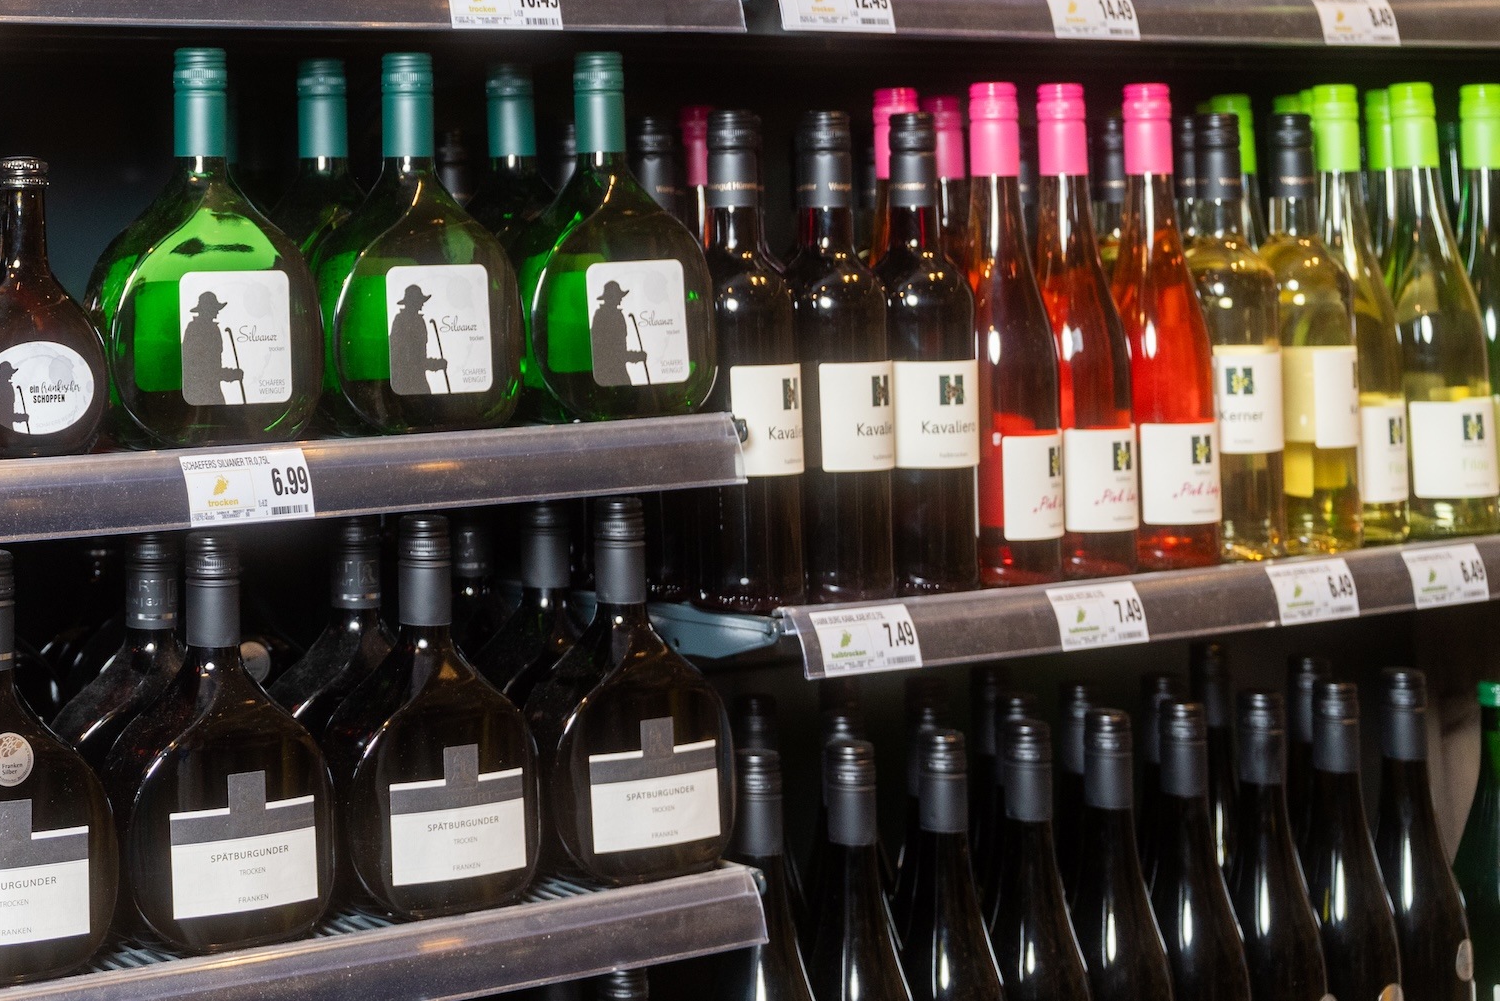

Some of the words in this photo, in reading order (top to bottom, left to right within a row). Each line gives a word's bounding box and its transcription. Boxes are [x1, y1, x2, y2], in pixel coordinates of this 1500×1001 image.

[468, 5, 497, 13] trocken
[439, 315, 477, 333] Silvaner
[237, 325, 277, 343] Silvaner
[29, 385, 39, 393] ein
[33, 394, 65, 403] SCHOPPEN
[182, 460, 217, 471] SCHAEFERS
[218, 458, 245, 468] SILVANER
[271, 466, 309, 496] 6.99
[207, 499, 239, 507] trocken
[1113, 598, 1142, 623] 7.49
[882, 621, 915, 648] 7.49
[626, 785, 695, 801] SPÄTBURGUNDER
[652, 804, 675, 814] TROCKEN
[427, 815, 499, 832] SPÄTBURGUNDER
[651, 830, 679, 839] FRANKEN
[453, 836, 478, 845] TROCKEN
[210, 844, 289, 863] SPÄTBURGUNDER
[239, 866, 266, 876] TROCKEN
[452, 862, 481, 871] FRANKEN
[0, 899, 29, 908] TROCKEN
[238, 893, 269, 904] FRANKEN
